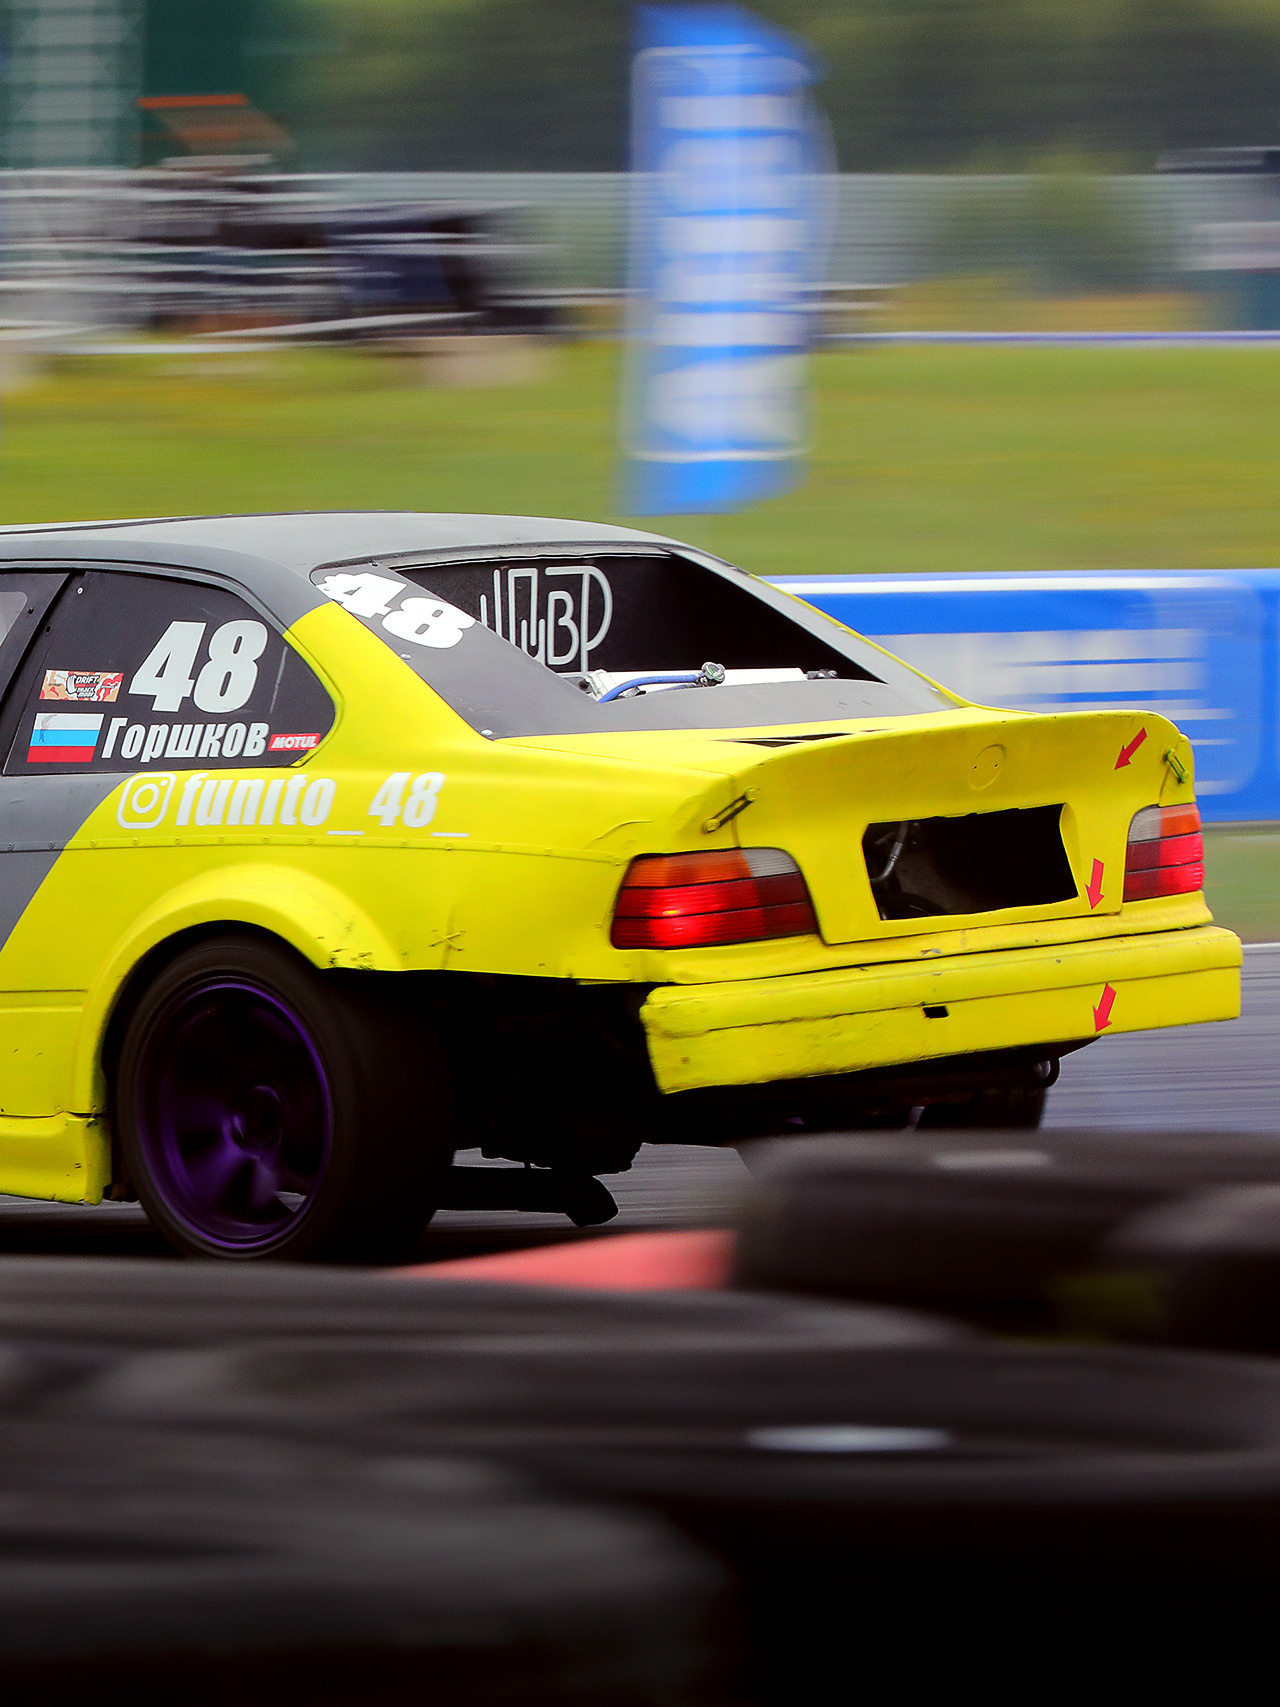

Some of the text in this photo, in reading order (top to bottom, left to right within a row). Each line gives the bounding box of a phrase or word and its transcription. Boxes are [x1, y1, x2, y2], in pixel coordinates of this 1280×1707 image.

[316, 572, 476, 649] 48
[128, 619, 268, 713] 48
[101, 717, 269, 763] Горшков
[271, 735, 317, 749] MOTUL
